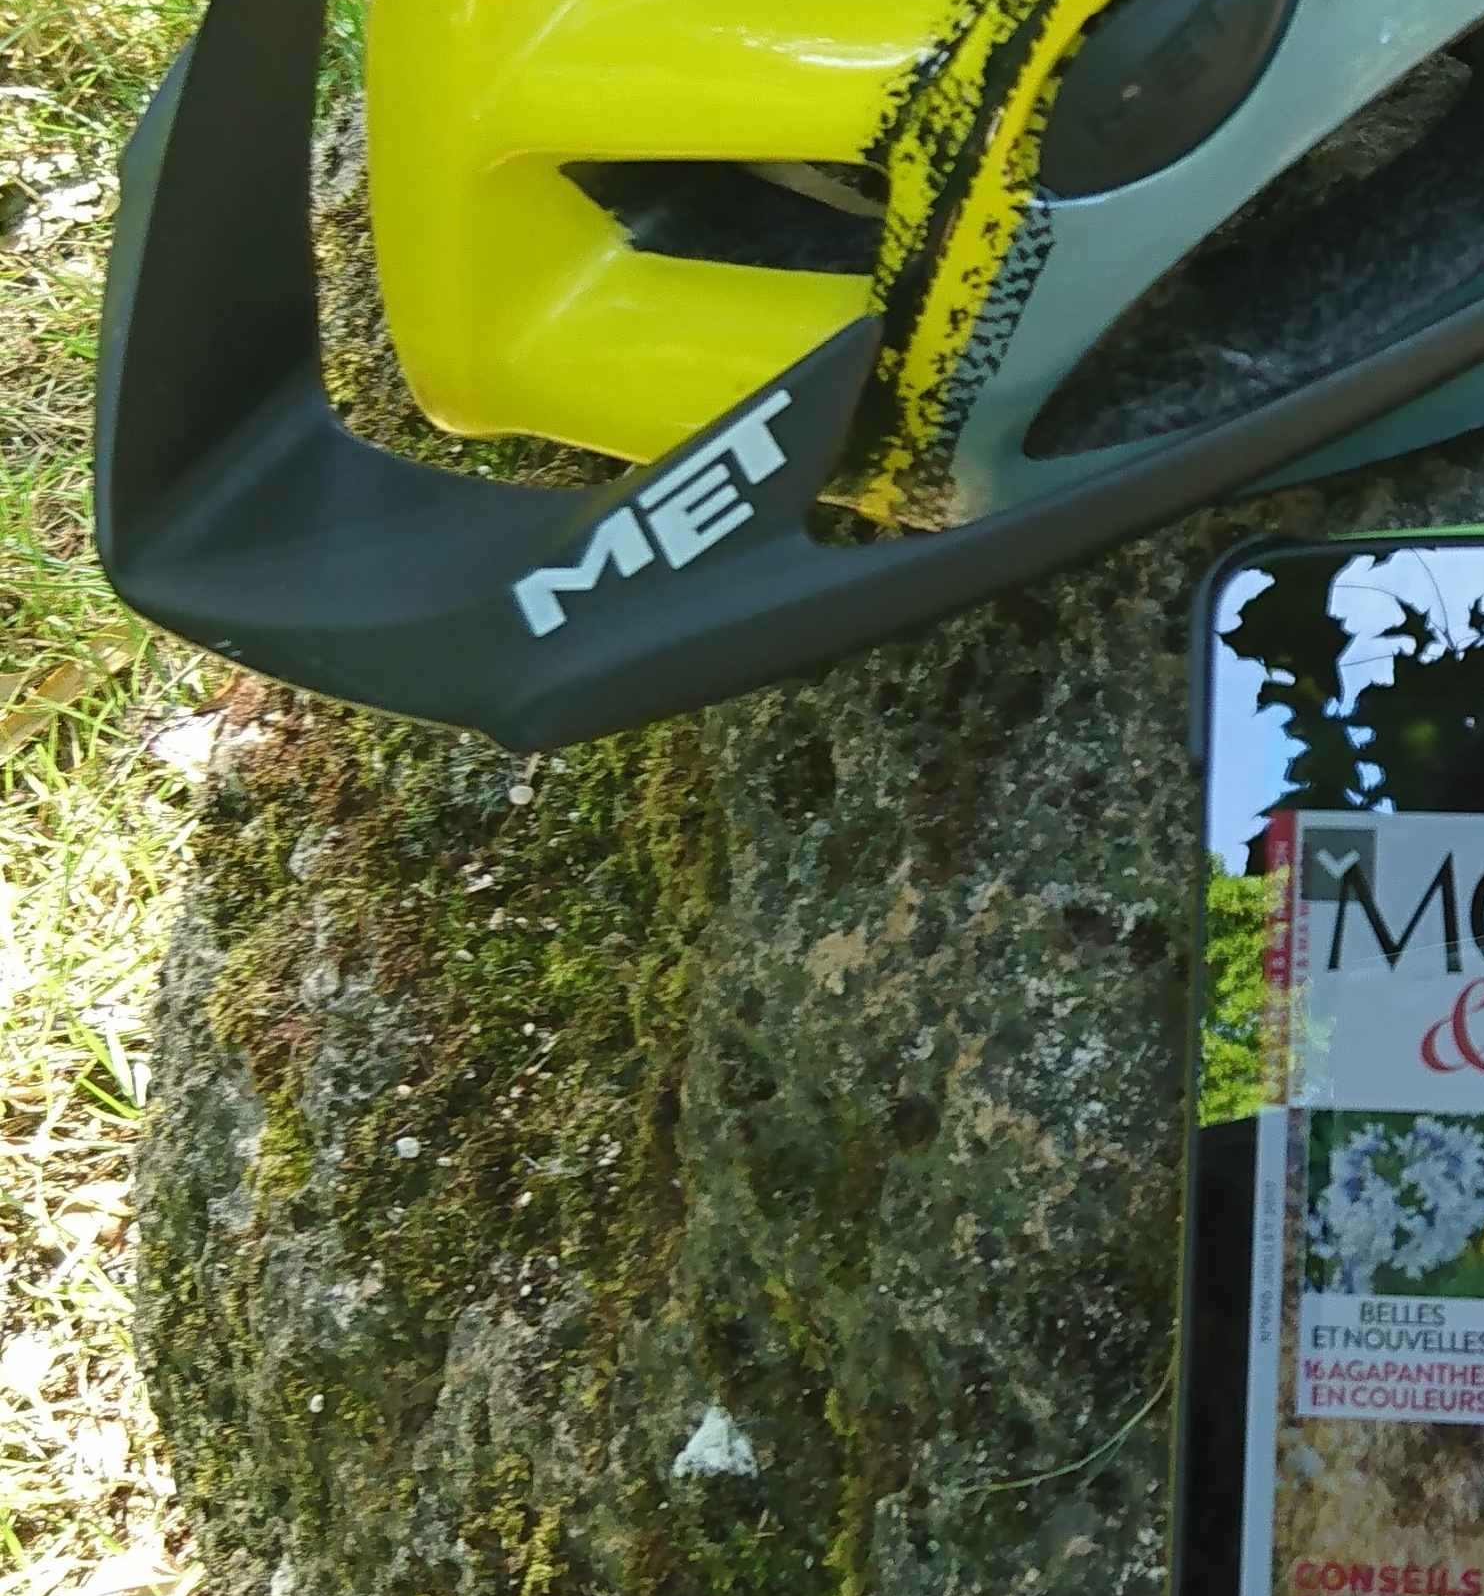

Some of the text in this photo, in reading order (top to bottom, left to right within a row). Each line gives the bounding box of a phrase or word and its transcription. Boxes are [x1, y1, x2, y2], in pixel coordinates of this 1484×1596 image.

[513, 388, 793, 638] MET
[1360, 1301, 1446, 1327] BELLES
[1312, 1324, 1341, 1350] ET
[1311, 1384, 1346, 1407] EN
